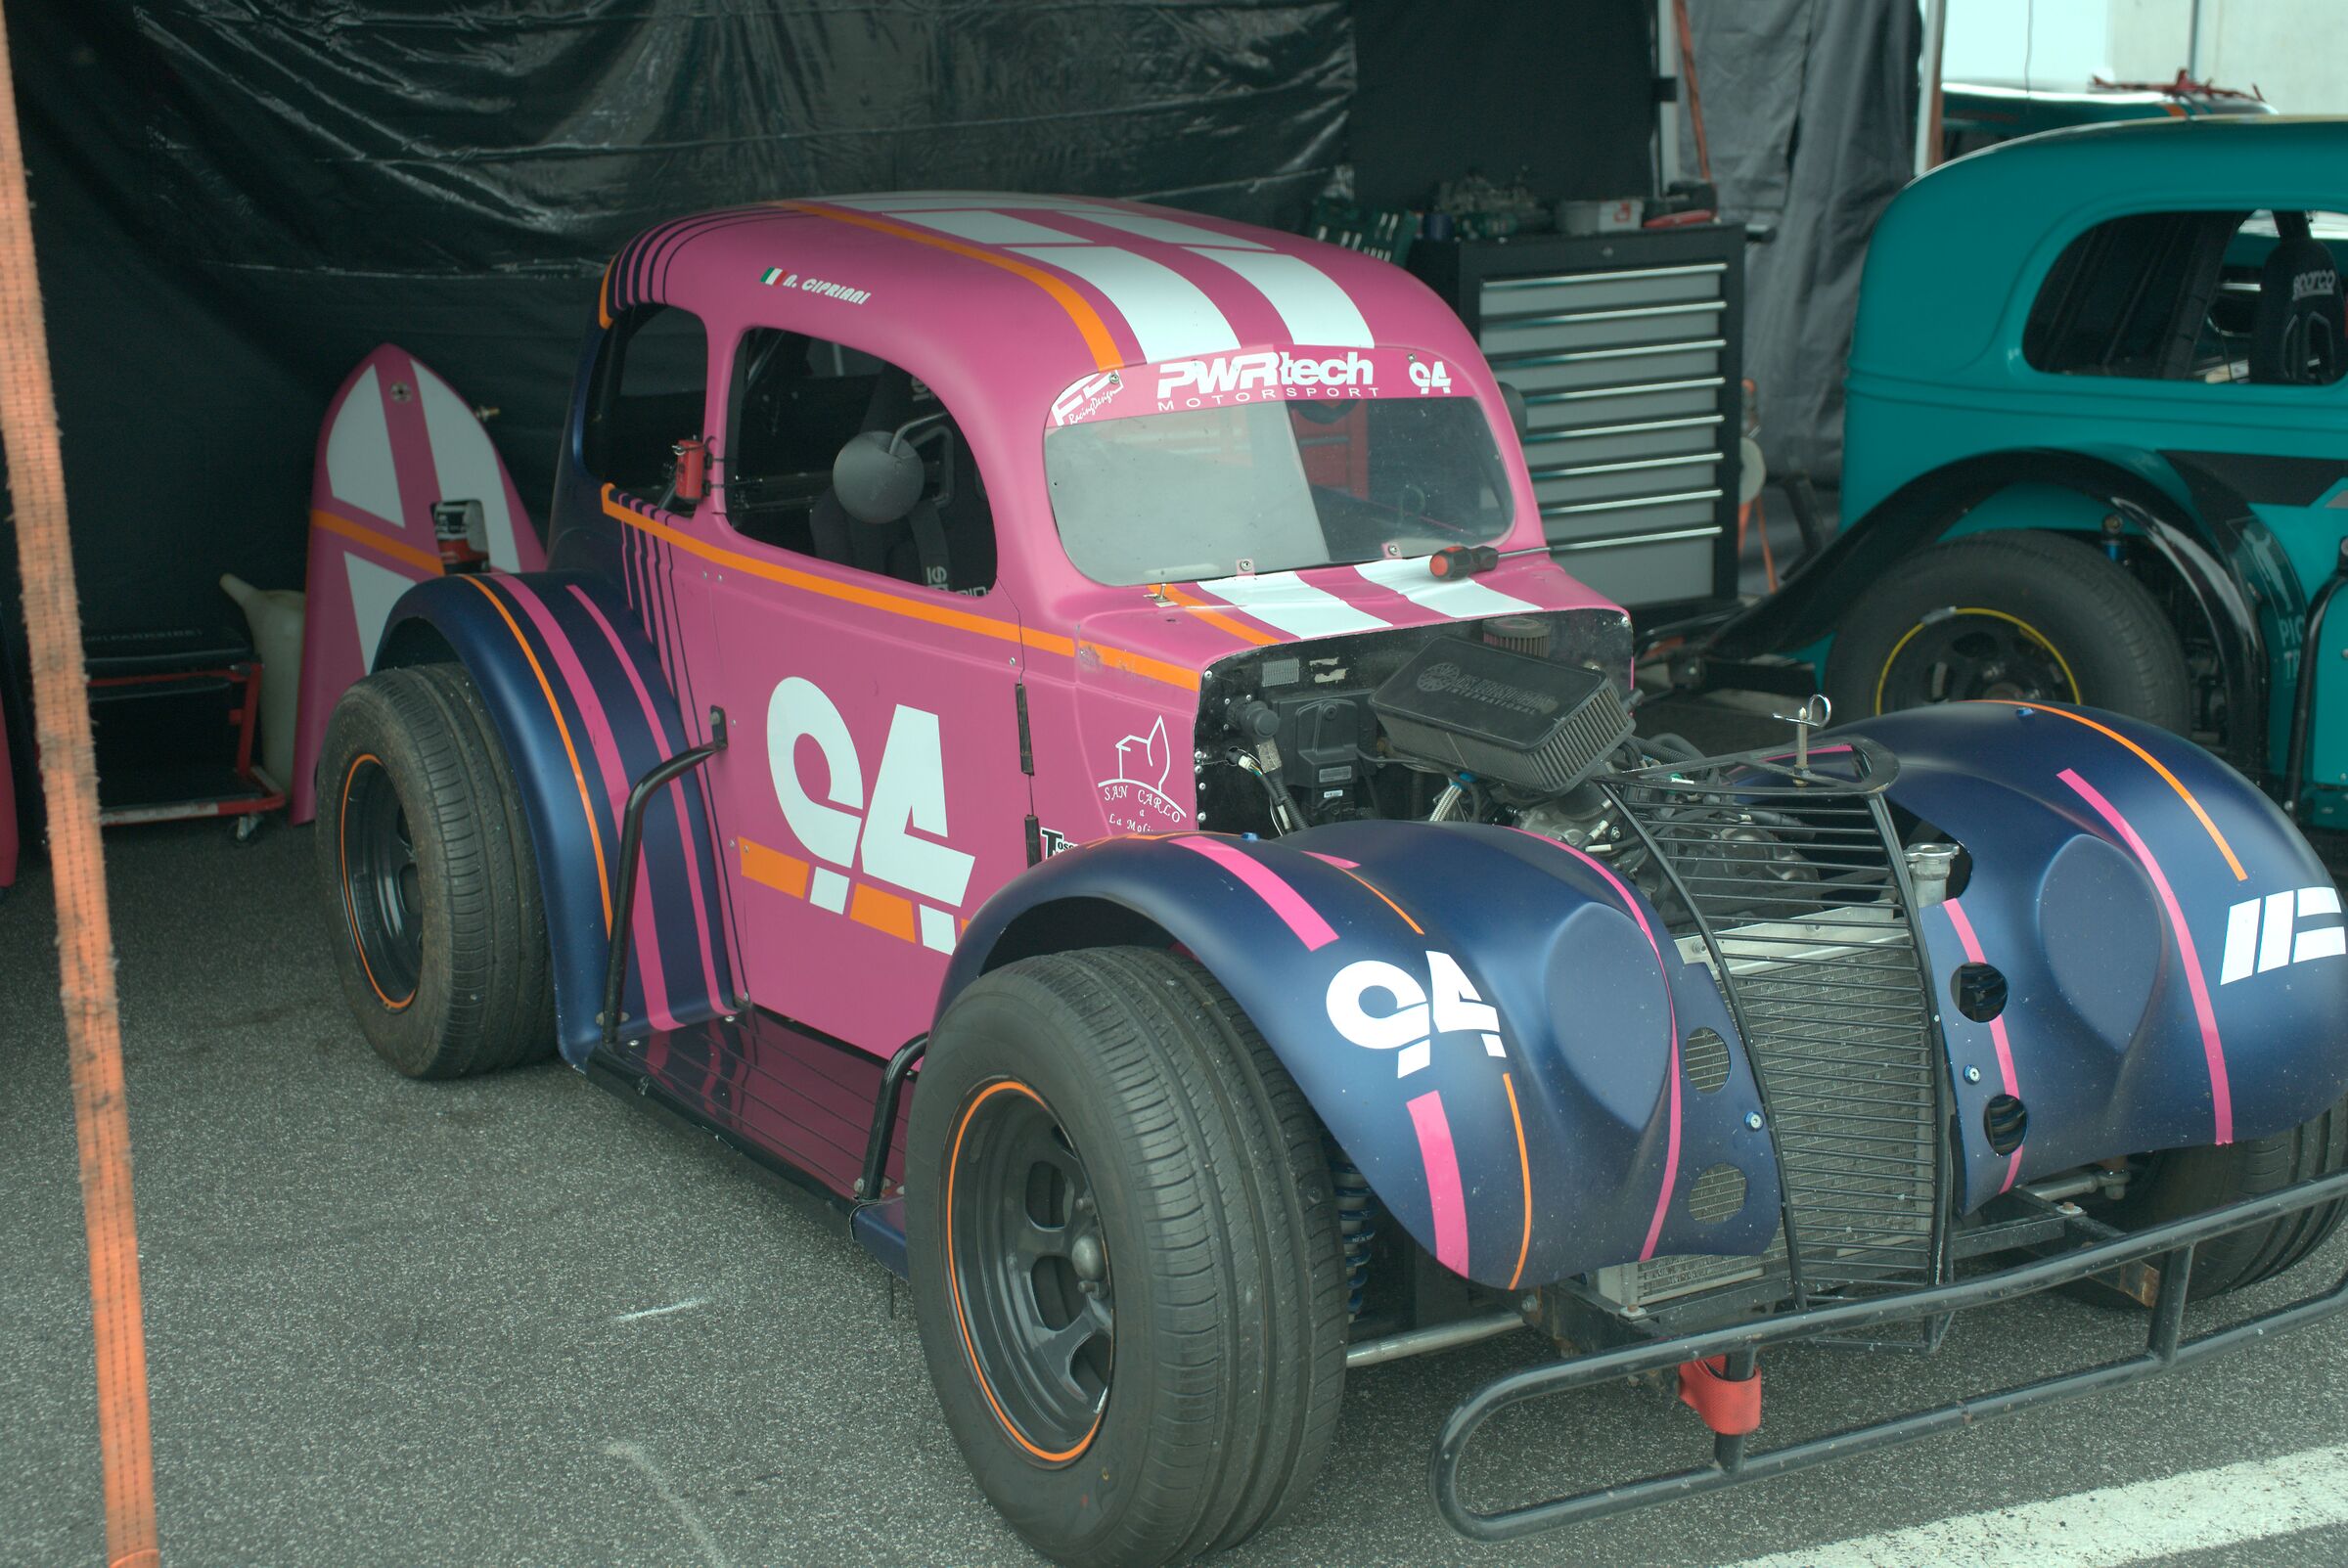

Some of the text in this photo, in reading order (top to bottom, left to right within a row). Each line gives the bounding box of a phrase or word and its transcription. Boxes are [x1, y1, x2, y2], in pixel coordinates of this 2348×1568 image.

[801, 278, 872, 305] CIPRIANI
[1157, 387, 1379, 411] MOTORSPORT
[766, 676, 976, 956] 94
[1105, 784, 1181, 823] SAN CARLO
[1108, 813, 1123, 827] La
[1326, 950, 1507, 1079] 94
